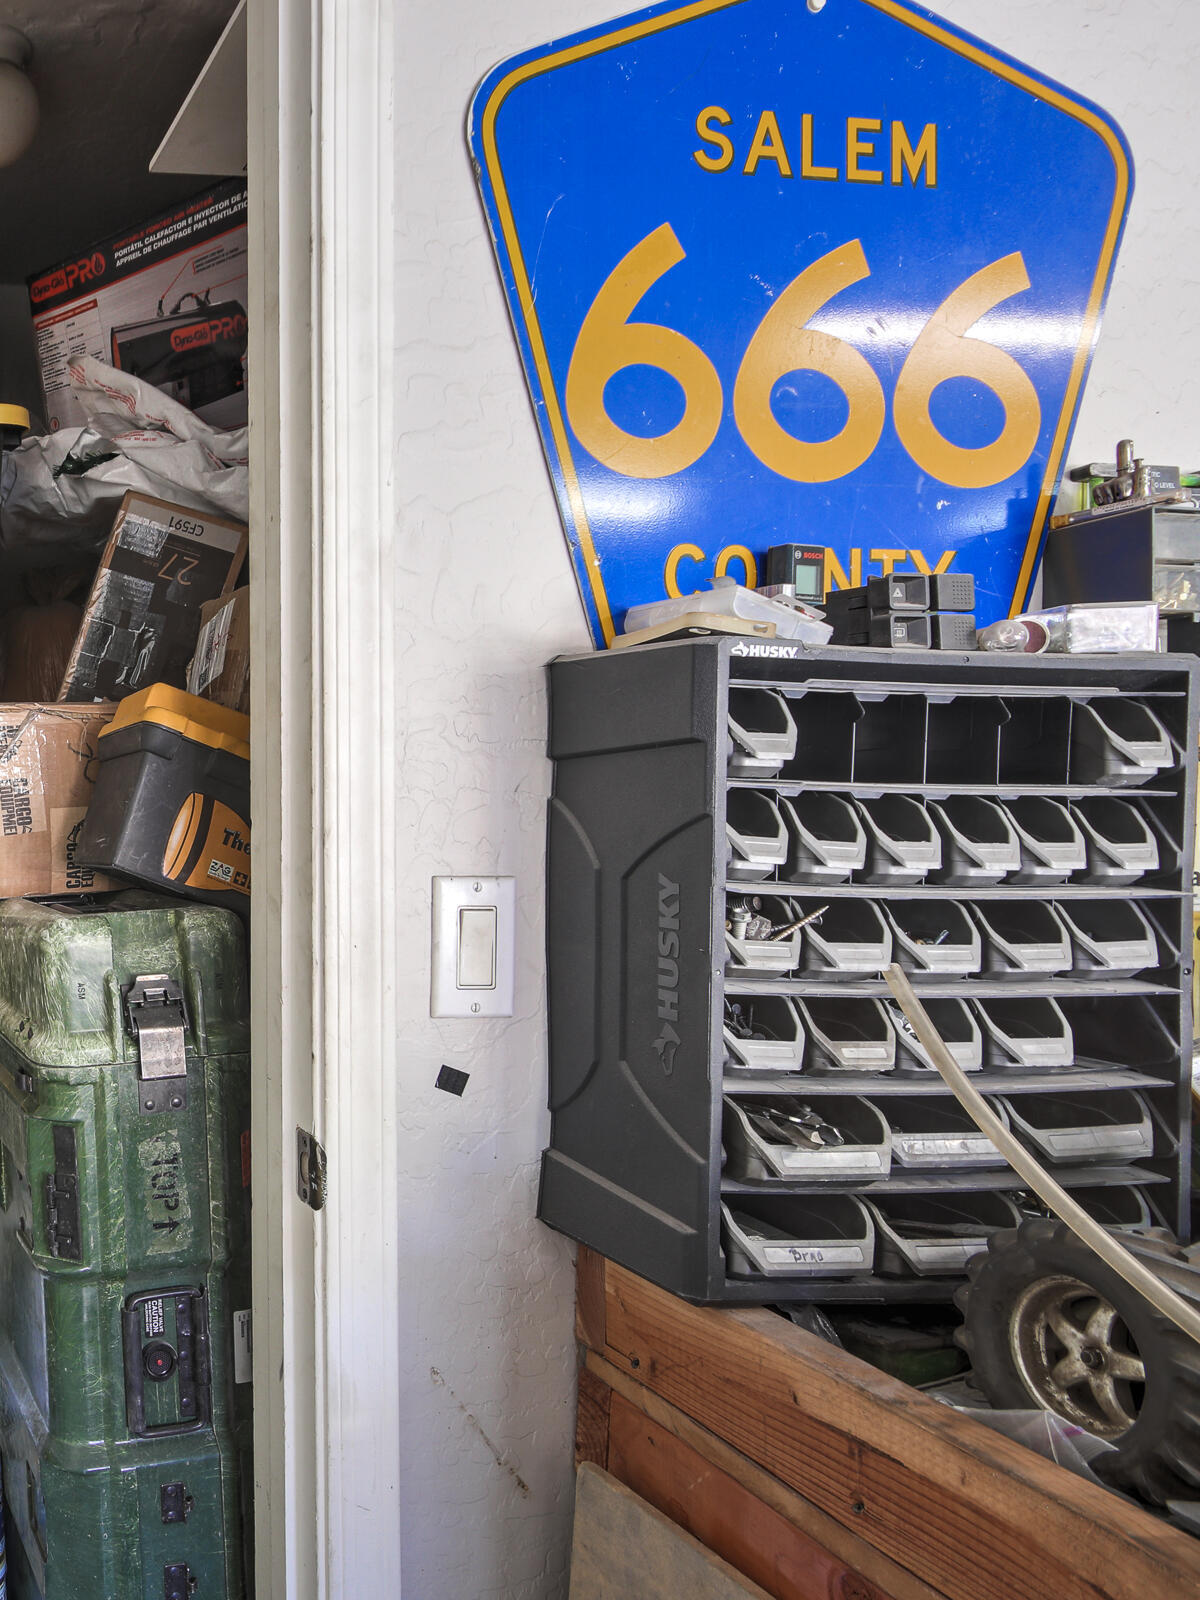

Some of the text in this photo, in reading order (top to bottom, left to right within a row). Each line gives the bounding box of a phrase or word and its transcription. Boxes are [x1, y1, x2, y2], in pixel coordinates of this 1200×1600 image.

[693, 105, 938, 188] SALEM
[144, 219, 187, 245] CALEFACTOR
[193, 198, 230, 221] INYECTOR
[153, 226, 192, 249] CHAUFFAGE
[566, 221, 1042, 489] 666
[169, 515, 204, 537] CF591
[158, 553, 199, 586] 27
[664, 542, 958, 604] CONTY
[803, 552, 824, 560] BOSCH
[749, 644, 799, 659] HUSKY
[13, 777, 32, 827] CARGO
[657, 872, 681, 1022] HUSKY
[77, 982, 85, 1000] ASM
